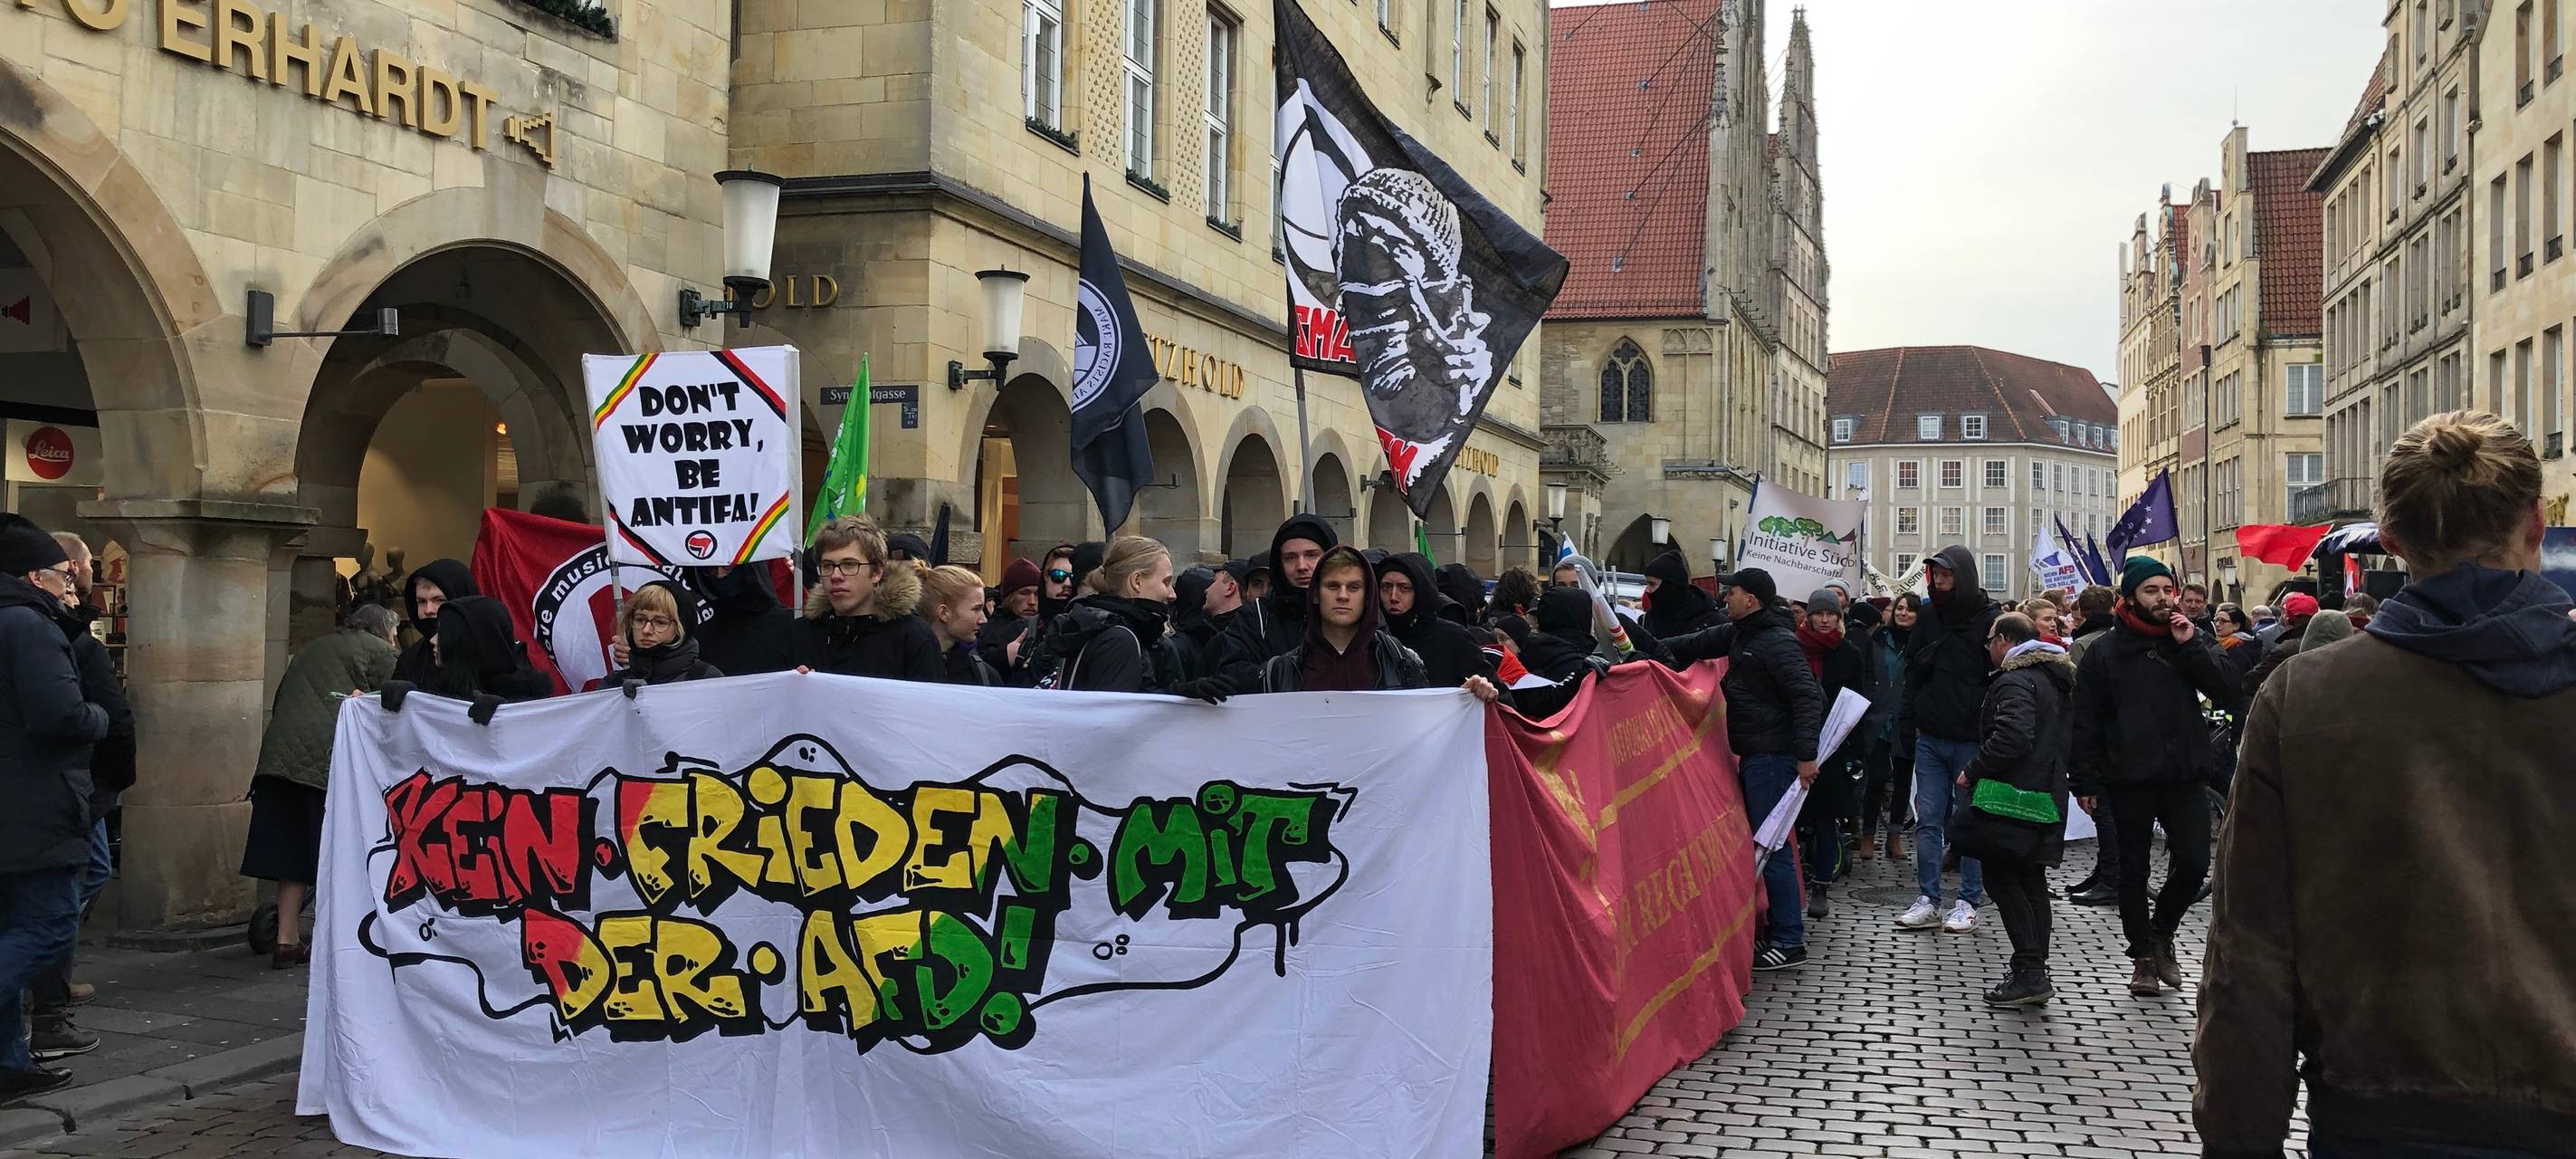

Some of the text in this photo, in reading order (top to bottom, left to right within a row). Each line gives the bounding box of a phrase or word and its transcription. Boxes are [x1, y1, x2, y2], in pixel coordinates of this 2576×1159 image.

[157, 0, 497, 149] ERHARDT
[1295, 304, 1357, 364] SMA
[1143, 332, 1244, 399] TZHOLD
[638, 381, 740, 417] DON'T
[29, 440, 70, 462] Leica
[620, 417, 764, 455] WORRY,
[674, 459, 720, 490] BE
[630, 493, 759, 528] ANTIFA!
[1746, 550, 1771, 561] Keine
[1750, 532, 1818, 560] Initiative
[520, 905, 762, 1042] DER
